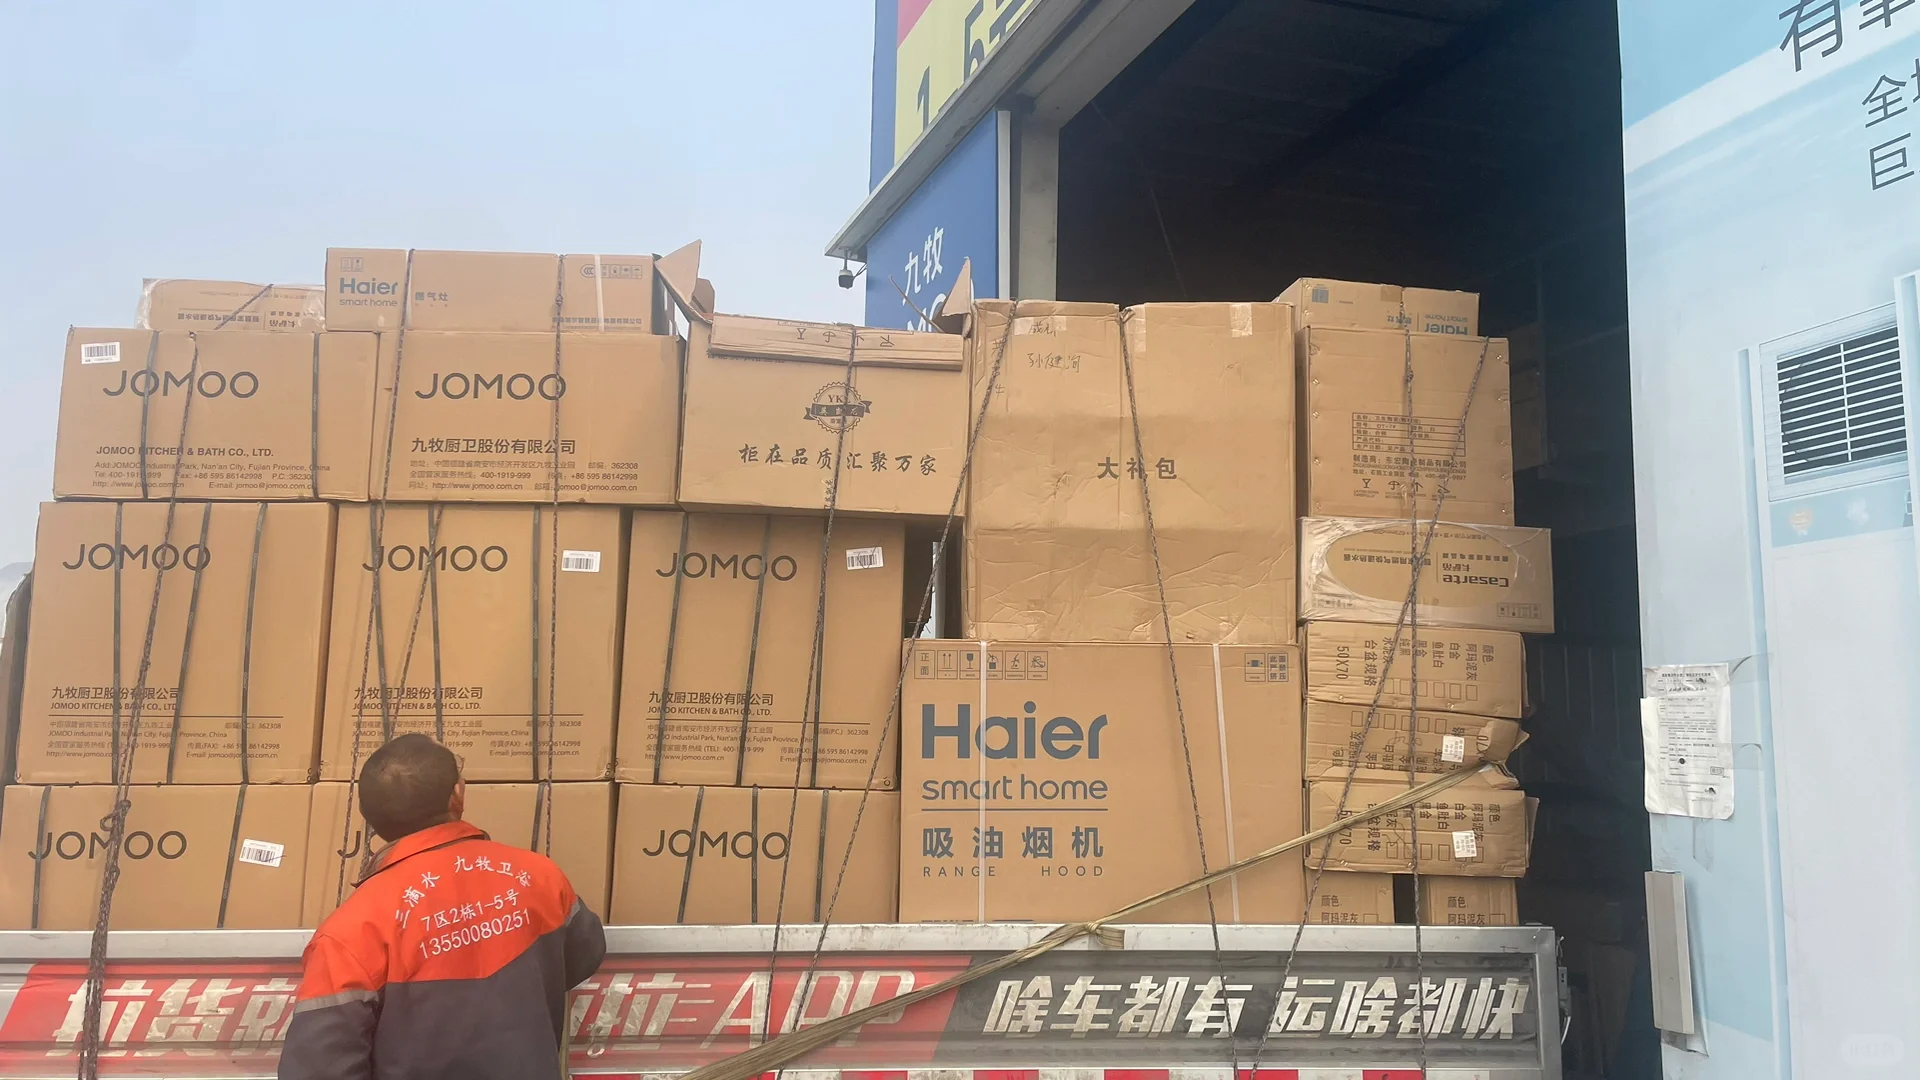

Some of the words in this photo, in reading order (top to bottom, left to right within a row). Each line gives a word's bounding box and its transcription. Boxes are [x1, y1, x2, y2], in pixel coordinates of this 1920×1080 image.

[902, 226, 945, 306] 九牧
[339, 278, 399, 296] Haier
[339, 298, 367, 307] smart
[369, 299, 398, 307] home
[102, 369, 260, 399] JOMOO
[414, 372, 567, 400] JOMOO
[96, 446, 136, 455] JOMOO
[187, 448, 194, 456] &
[197, 448, 226, 456] BATH
[252, 448, 274, 457] LTD.
[411, 437, 577, 454] 九牧厨卫股份有限公司
[1097, 456, 1178, 480] 大礼包
[62, 543, 211, 571] JOMOO
[362, 545, 508, 571] JOMOO
[655, 552, 798, 581] JOMOO
[1442, 574, 1509, 588] Casarte
[1335, 645, 1350, 681] 50X70
[1363, 639, 1378, 687] 台盆规格
[1432, 641, 1445, 668] 鱼肚白
[1449, 642, 1461, 660] 白金
[1465, 643, 1478, 681] 阿玛泥灰
[50, 702, 80, 710] JOMOO
[719, 708, 739, 716] BATH
[921, 701, 1108, 760] Haier
[921, 775, 1013, 800] smart
[1020, 774, 1108, 800] home
[1436, 802, 1450, 830] 鱼肚白
[1454, 803, 1467, 821] 白金
[27, 830, 188, 860] JOMOO
[642, 829, 790, 860] JOMOO
[922, 826, 1104, 859] 吸油烟机
[923, 865, 997, 877] RANGE
[1041, 865, 1104, 877] HOOD
[1321, 912, 1359, 924] 阿玛泥灰
[1447, 913, 1486, 925] 阿玛泥灰
[419, 907, 531, 960] 13550080251
[699, 970, 916, 1050] APP
[981, 975, 1253, 1039] 啥车都有
[1268, 975, 1530, 1040] 运啥都快
